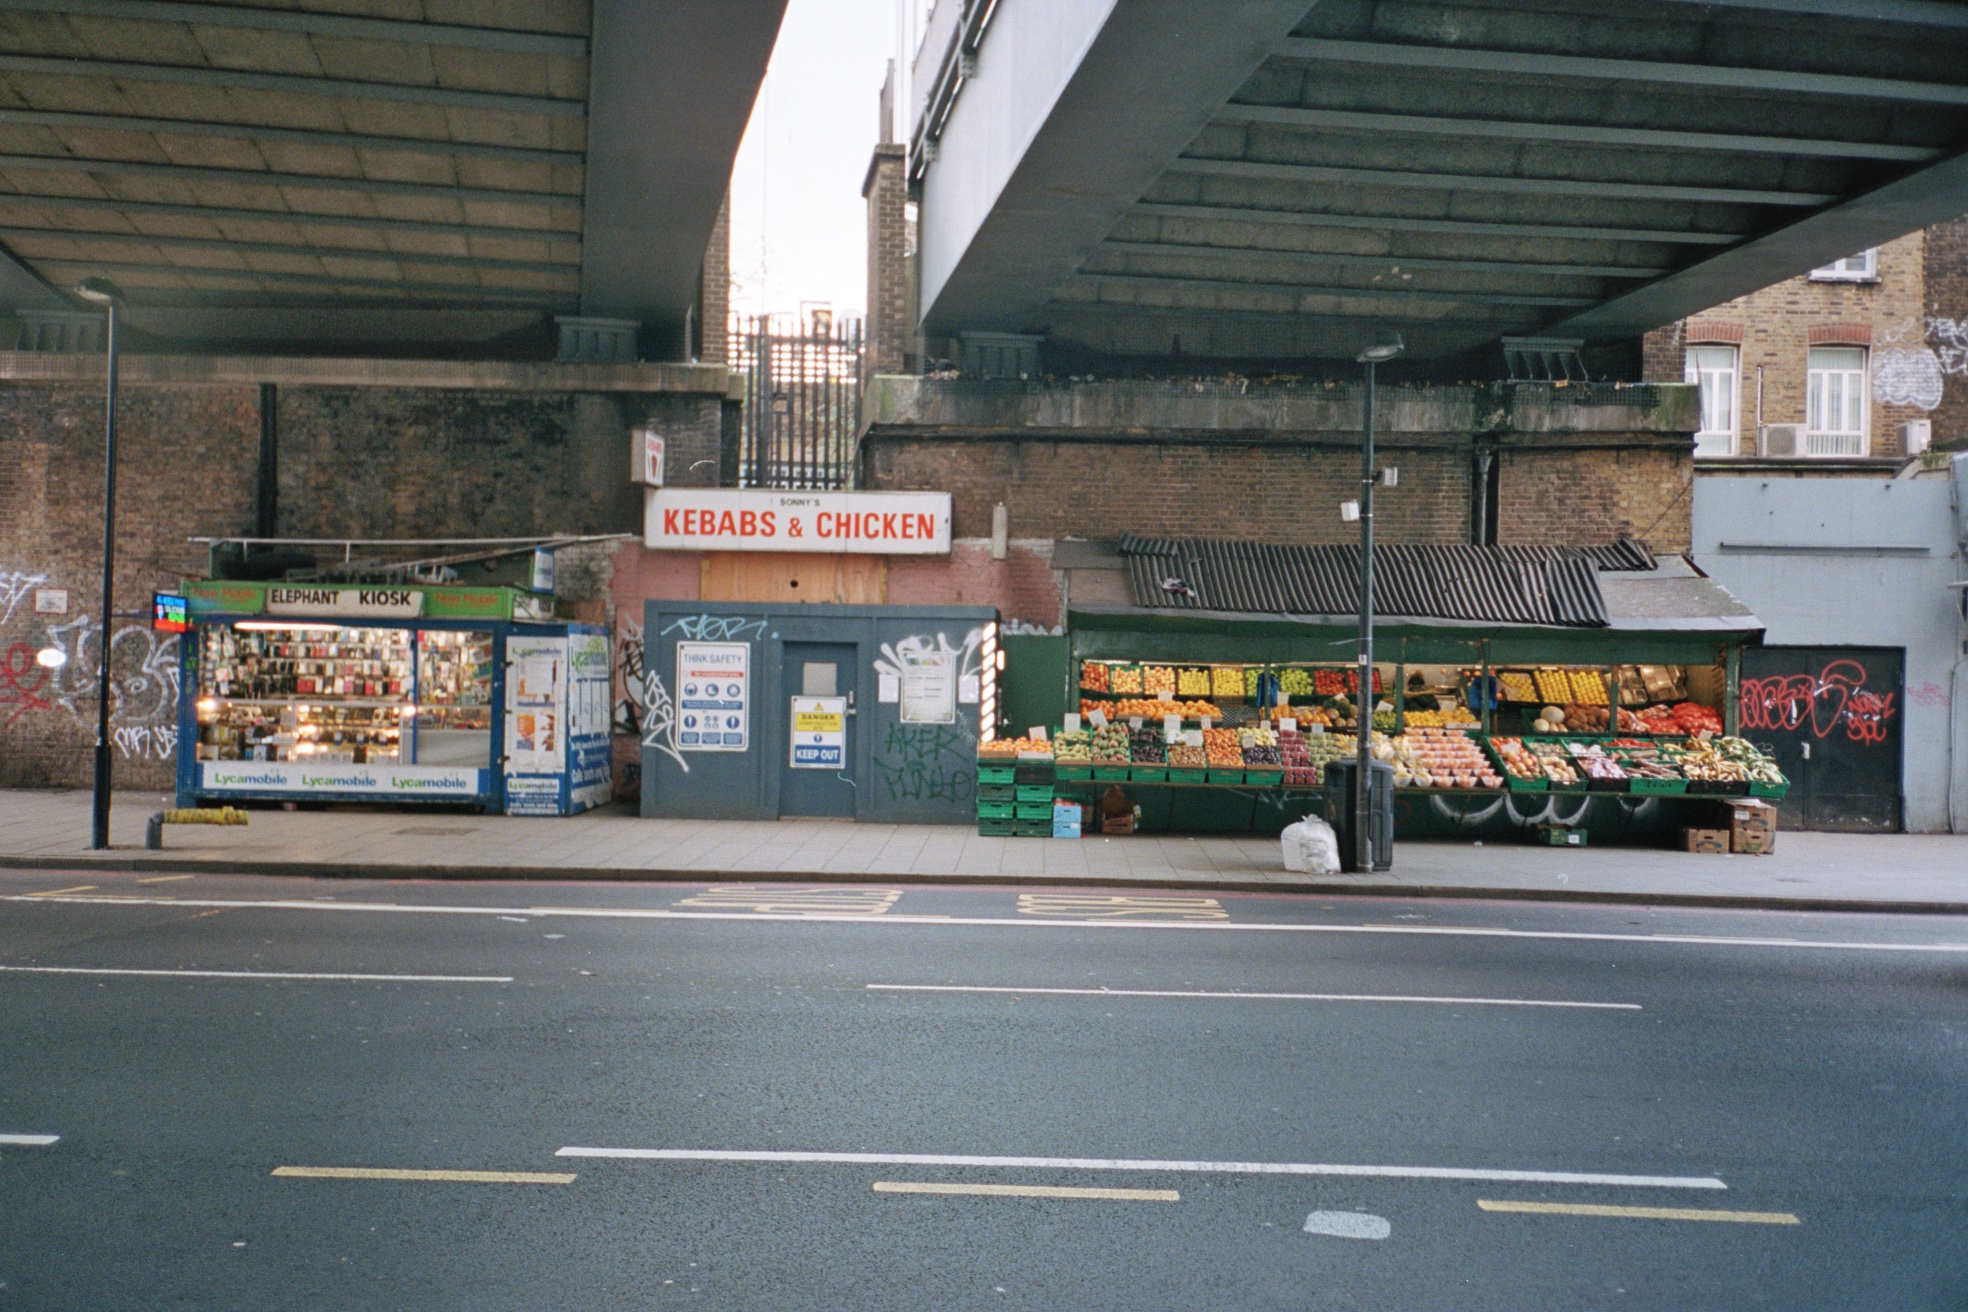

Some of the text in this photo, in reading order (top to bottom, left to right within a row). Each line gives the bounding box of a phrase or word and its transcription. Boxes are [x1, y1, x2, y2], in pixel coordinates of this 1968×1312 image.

[664, 508, 935, 539] KEBABS & CHICKEN
[271, 589, 412, 606] ELEPHANT KIOSK
[684, 653, 742, 664] THINK SAFETY
[796, 749, 839, 760] KEEP OUT
[214, 772, 288, 787] Lycamobile
[302, 772, 377, 788] Lycamobile
[391, 774, 467, 790] Lycamobile
